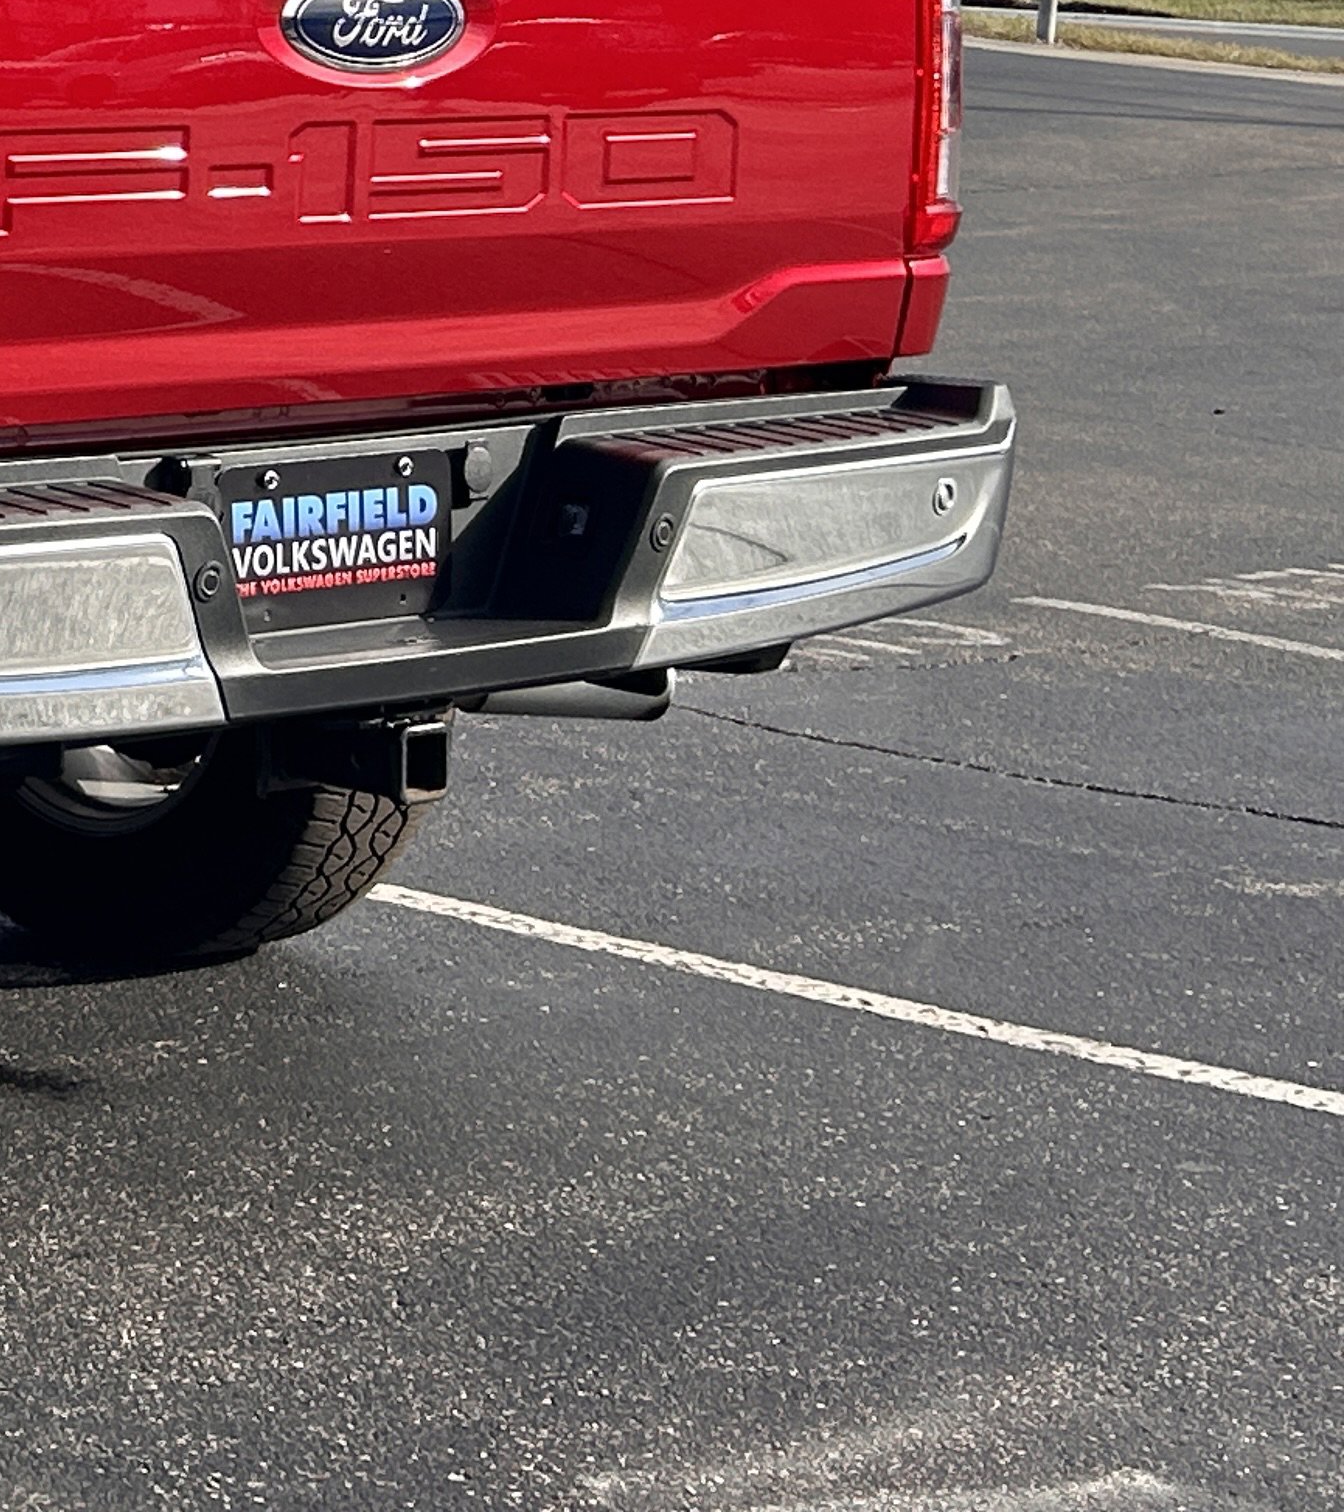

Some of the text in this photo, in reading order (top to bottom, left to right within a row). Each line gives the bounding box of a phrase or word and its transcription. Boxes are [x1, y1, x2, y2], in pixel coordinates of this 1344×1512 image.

[231, 484, 438, 544] FAIRFIELD
[231, 527, 437, 579] VOLKSWAGEN
[261, 571, 353, 595] VOLKSWAGEN
[356, 561, 437, 584] SUPERSTORE
